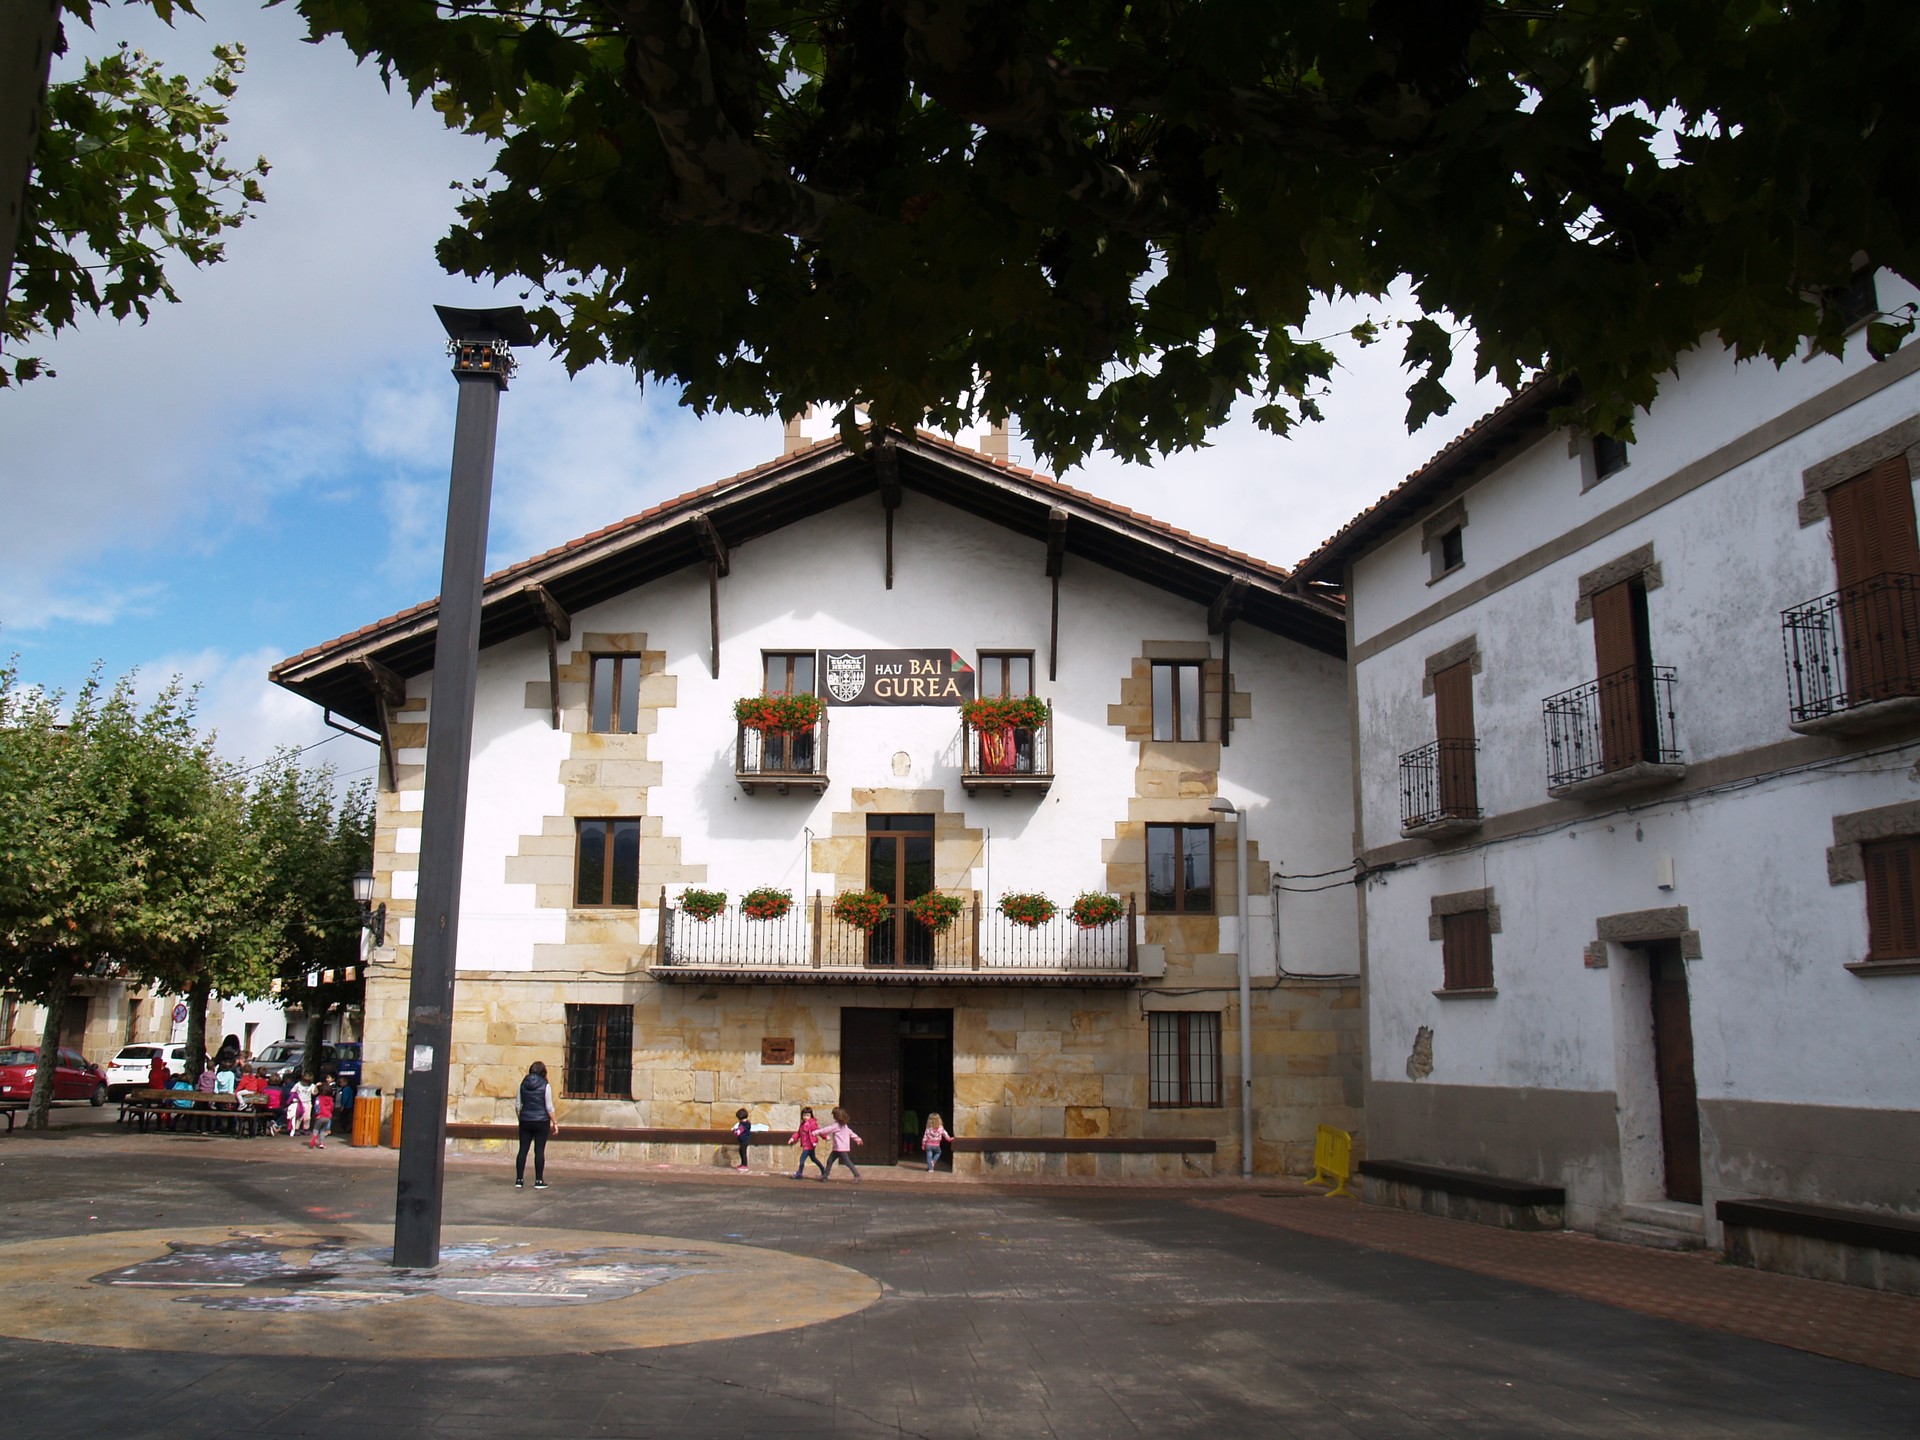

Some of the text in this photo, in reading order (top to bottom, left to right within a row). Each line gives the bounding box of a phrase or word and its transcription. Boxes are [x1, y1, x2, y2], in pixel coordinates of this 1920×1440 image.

[875, 659, 942, 675] HAU BAI
[874, 677, 961, 698] GUREA
